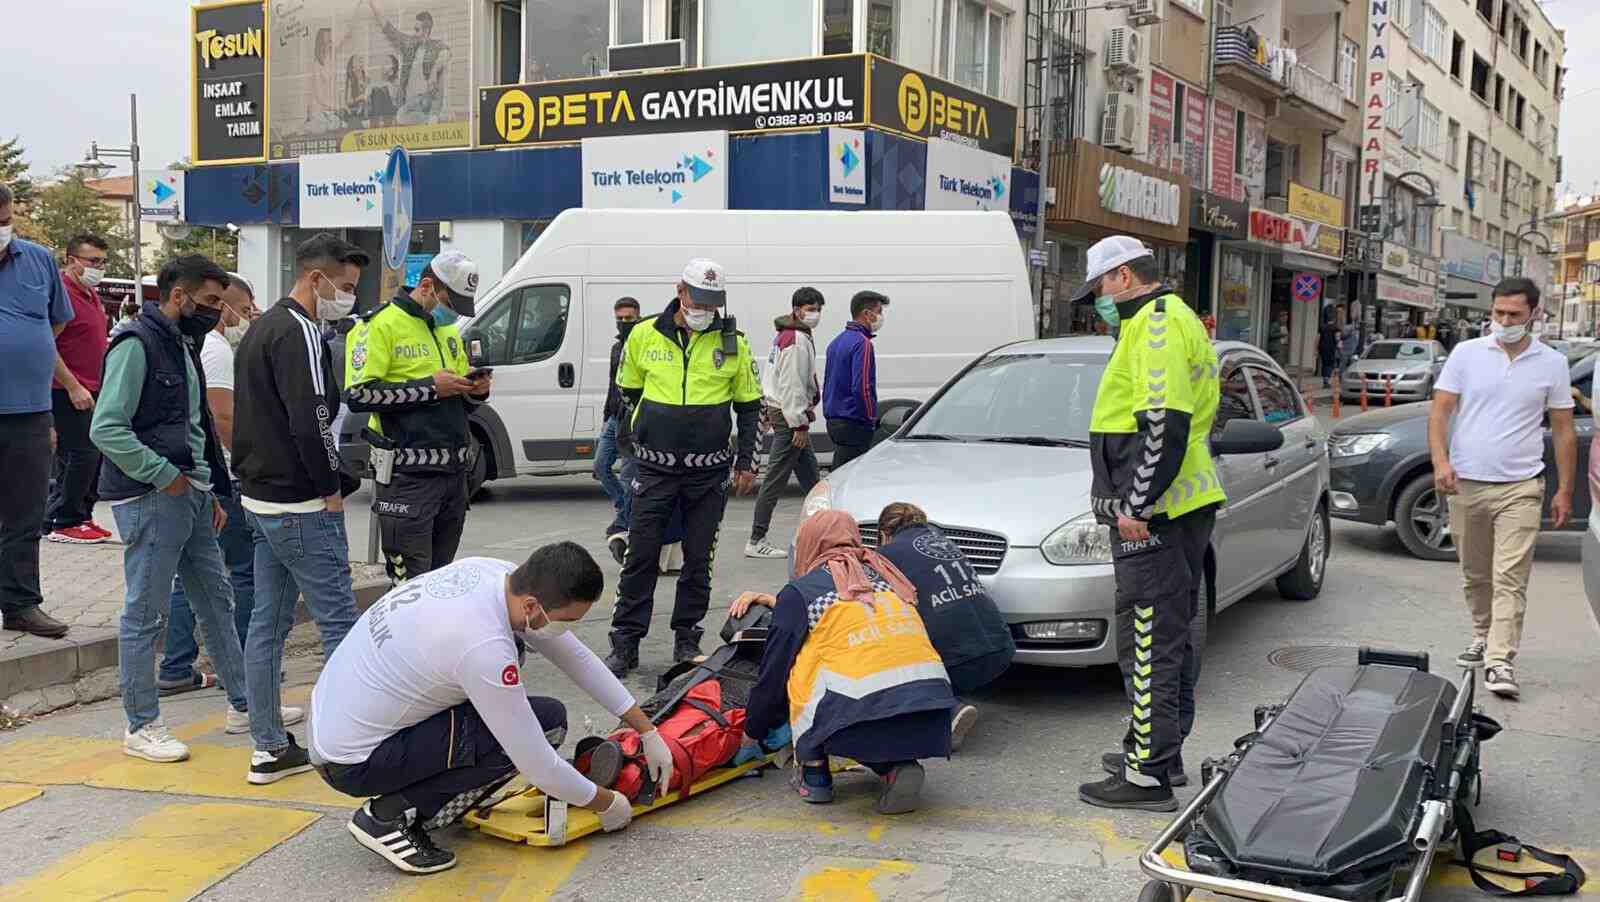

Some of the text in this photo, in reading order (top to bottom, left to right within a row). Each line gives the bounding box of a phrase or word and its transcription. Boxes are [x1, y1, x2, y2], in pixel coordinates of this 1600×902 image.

[203, 82, 242, 98] İNŞAAT
[215, 101, 252, 118] EMLAK
[538, 76, 854, 138] BETA GAYRİMENKUL
[930, 91, 989, 139] BETA
[768, 111, 854, 127] 0382 20 30 184
[226, 121, 260, 137] TARIM
[367, 134, 388, 147] SUN
[592, 169, 686, 187] Türk Telekom
[306, 181, 376, 197] Türk Telekom
[939, 174, 992, 201] Türk Telekom
[394, 344, 430, 359] POLİS
[930, 586, 962, 608] ACİL
